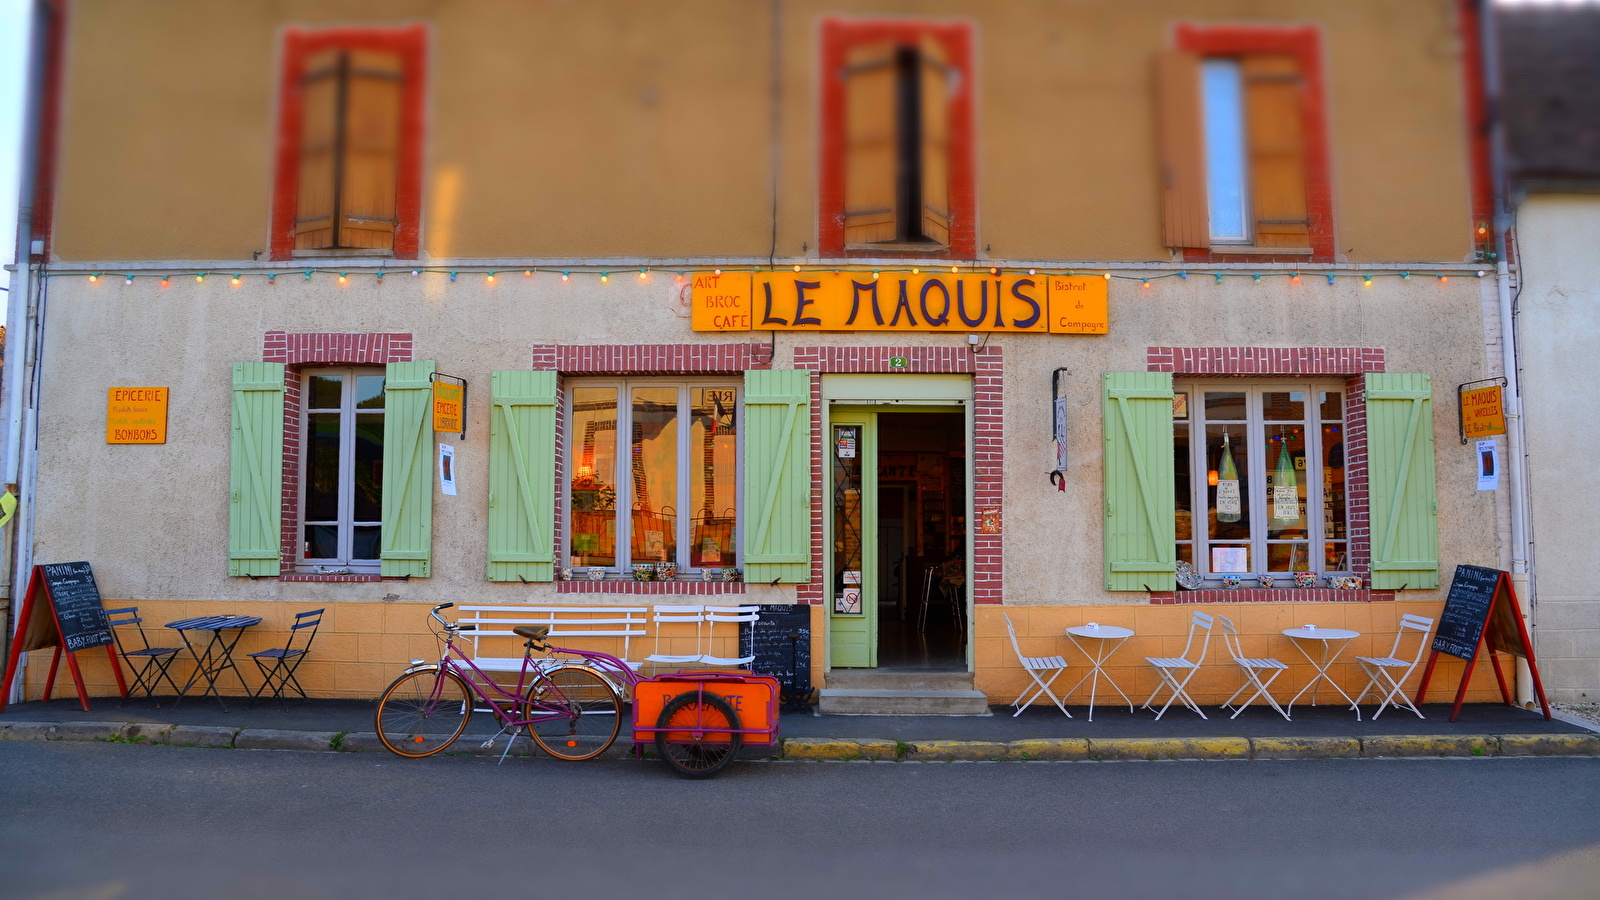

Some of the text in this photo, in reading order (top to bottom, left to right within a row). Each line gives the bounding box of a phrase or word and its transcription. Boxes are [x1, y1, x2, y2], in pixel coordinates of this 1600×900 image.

[694, 276, 718, 288] ART
[1054, 281, 1086, 291] Bistrot
[706, 296, 740, 308] BROC
[763, 278, 1040, 328] LE MAQUIS
[714, 310, 749, 328] CAFÉ
[1060, 317, 1104, 330] Campagne
[895, 358, 902, 366] 2
[1463, 390, 1497, 406] LE MAQUIS
[114, 429, 158, 440] BONBONS
[45, 565, 72, 577] PANINI
[1458, 566, 1482, 581] PANINI
